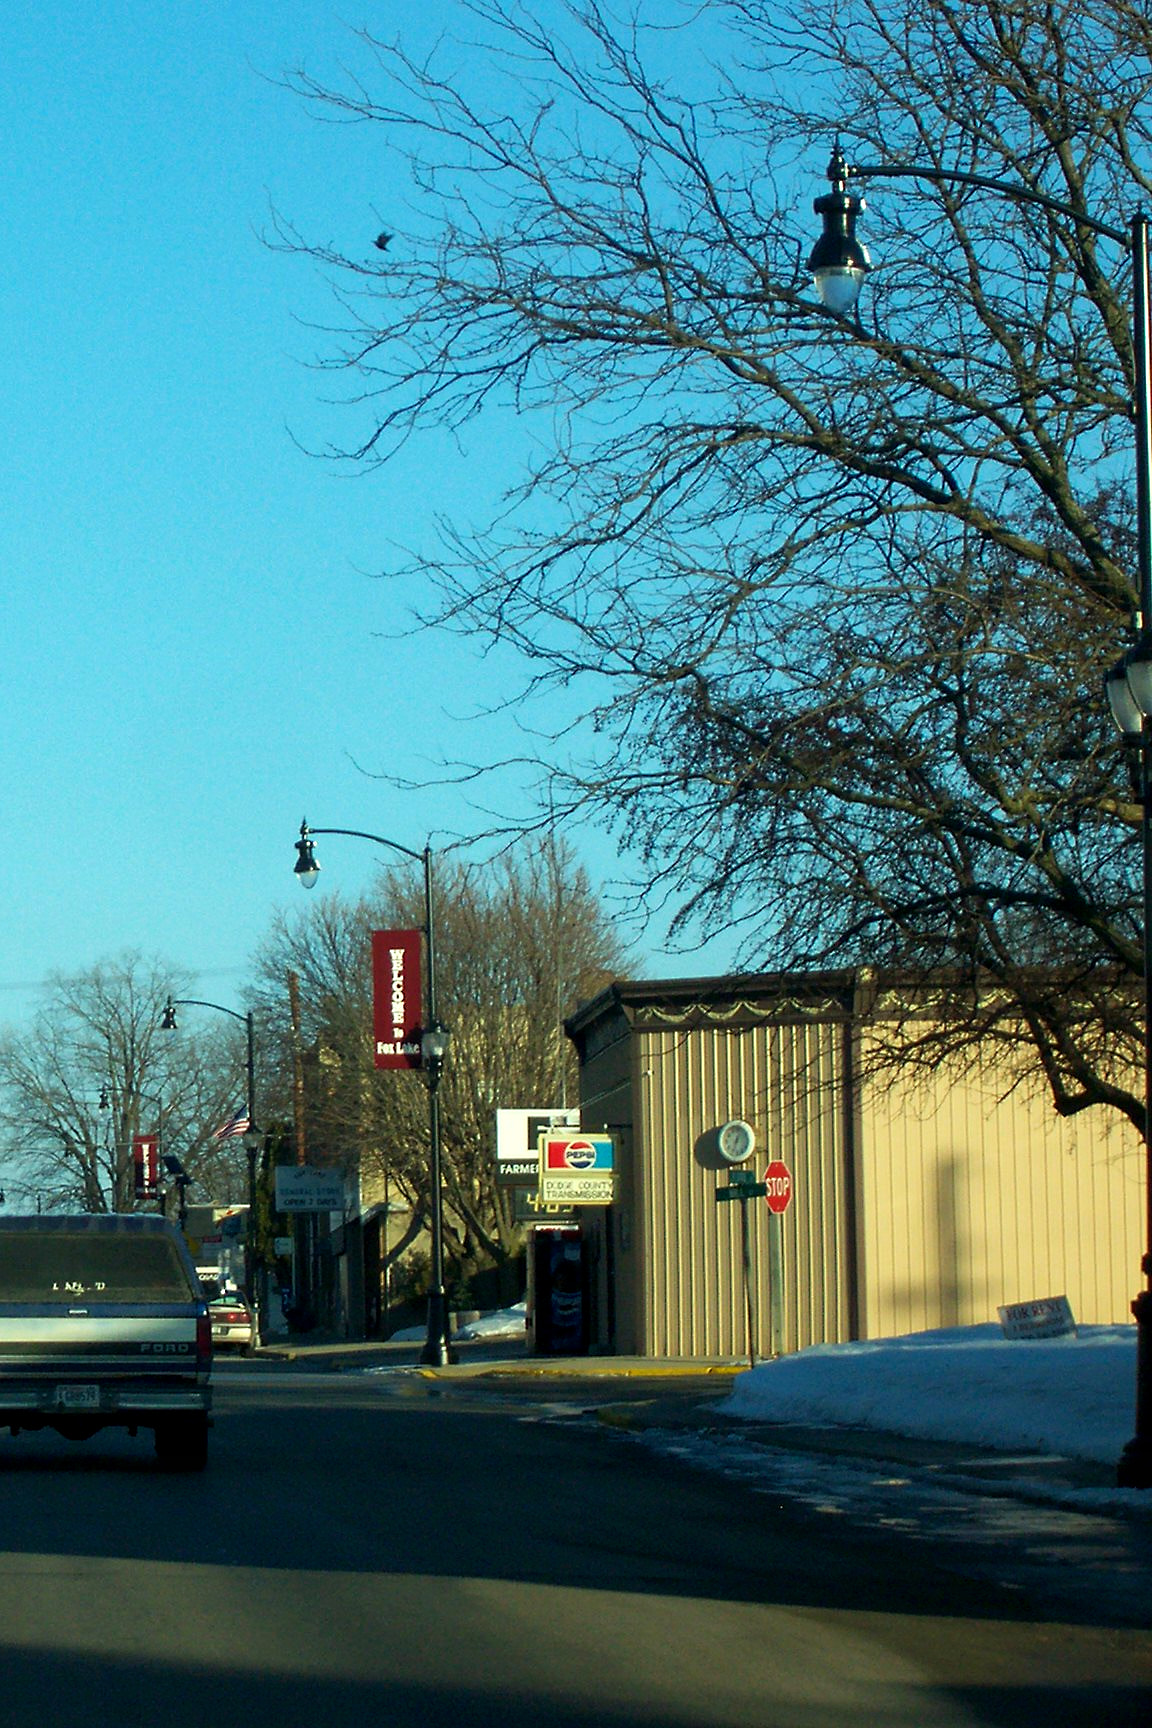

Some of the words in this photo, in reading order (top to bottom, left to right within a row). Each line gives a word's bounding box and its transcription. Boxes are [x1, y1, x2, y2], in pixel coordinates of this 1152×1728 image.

[389, 948, 405, 1024] WELCOME
[393, 1027, 404, 1038] To
[376, 1041, 395, 1054] Fox
[396, 1041, 420, 1054] Lake
[566, 1150, 595, 1159] PEPSI
[578, 1181, 613, 1190] COUNTY
[765, 1177, 790, 1197] STOP
[546, 1190, 613, 1199] TRANSMISSION
[140, 1343, 189, 1352] FORD
